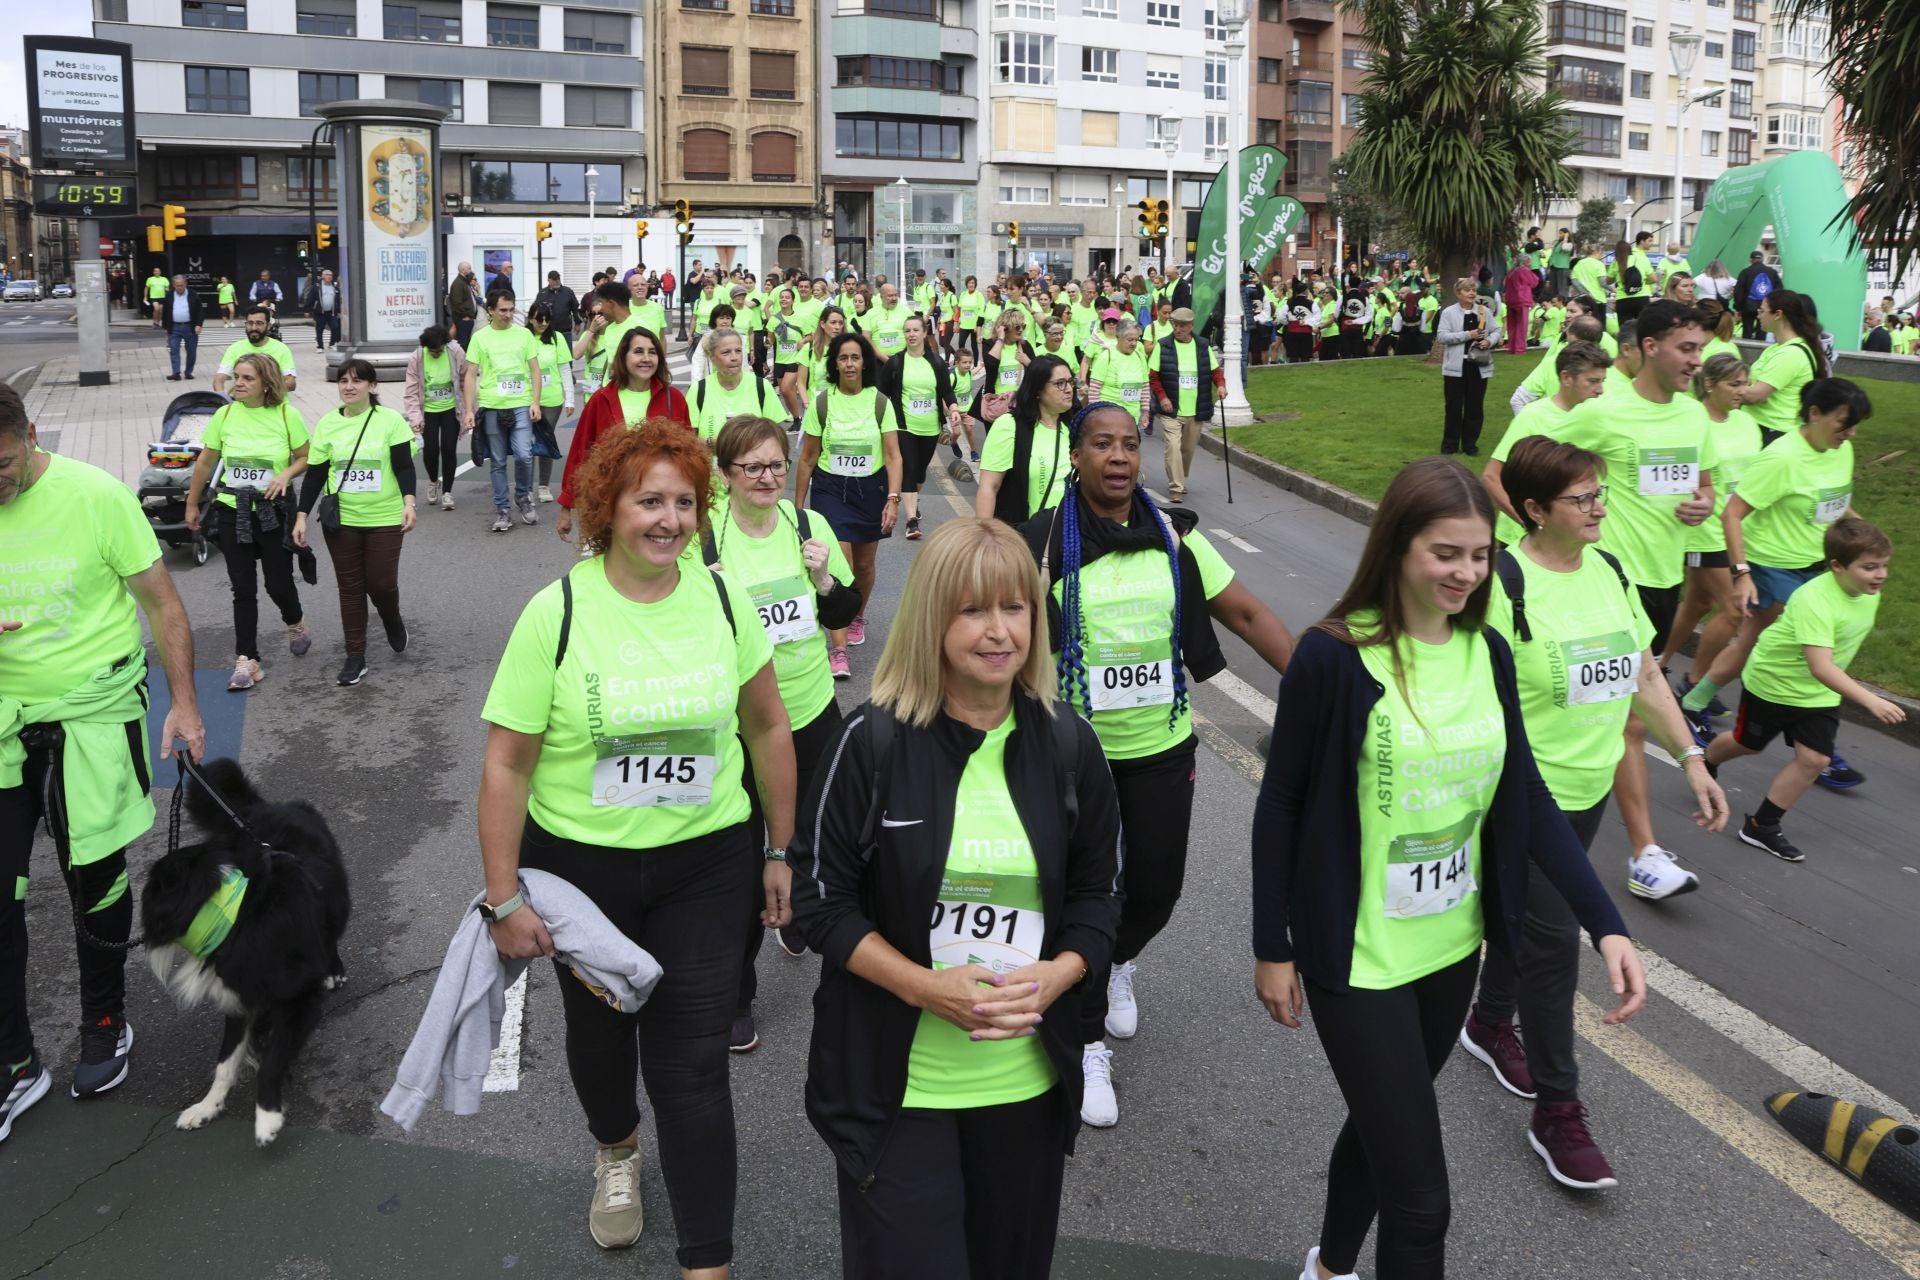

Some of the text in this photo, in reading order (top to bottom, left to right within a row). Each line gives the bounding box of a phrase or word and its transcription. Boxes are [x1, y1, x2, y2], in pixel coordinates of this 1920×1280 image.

[43, 70, 119, 83] PROGRESIVOS
[56, 60, 106, 71] Mes de los
[66, 90, 107, 99] PROGRESIVA
[59, 185, 122, 204] 10:59
[1257, 202, 1296, 249] Inglés
[380, 250, 427, 264] EL REFUGIO
[1201, 252, 1225, 275] El
[386, 295, 425, 307] NETFLIX
[389, 308, 433, 316] DISPONIBLE
[501, 381, 521, 389] 0572
[912, 400, 932, 409] 0758
[837, 456, 866, 467] 1702
[233, 467, 266, 480] 0367
[342, 470, 375, 482] 0934
[1651, 464, 1689, 482] 1189
[0, 576, 75, 599] ntra el
[757, 600, 801, 628] 602
[1090, 600, 1162, 621] contra
[1103, 662, 1162, 689] 0964
[1544, 640, 1567, 710] ASTURIAS
[1581, 656, 1632, 687] 0650
[607, 676, 639, 697] En
[586, 672, 604, 747] TURIAS
[610, 681, 735, 725] contra el
[616, 756, 697, 784] 1145
[1375, 714, 1393, 818] ASTURIAS
[1401, 748, 1488, 779] contra
[963, 837, 1033, 860] mar
[1409, 847, 1467, 893] 1144
[929, 901, 1020, 944] 0191
